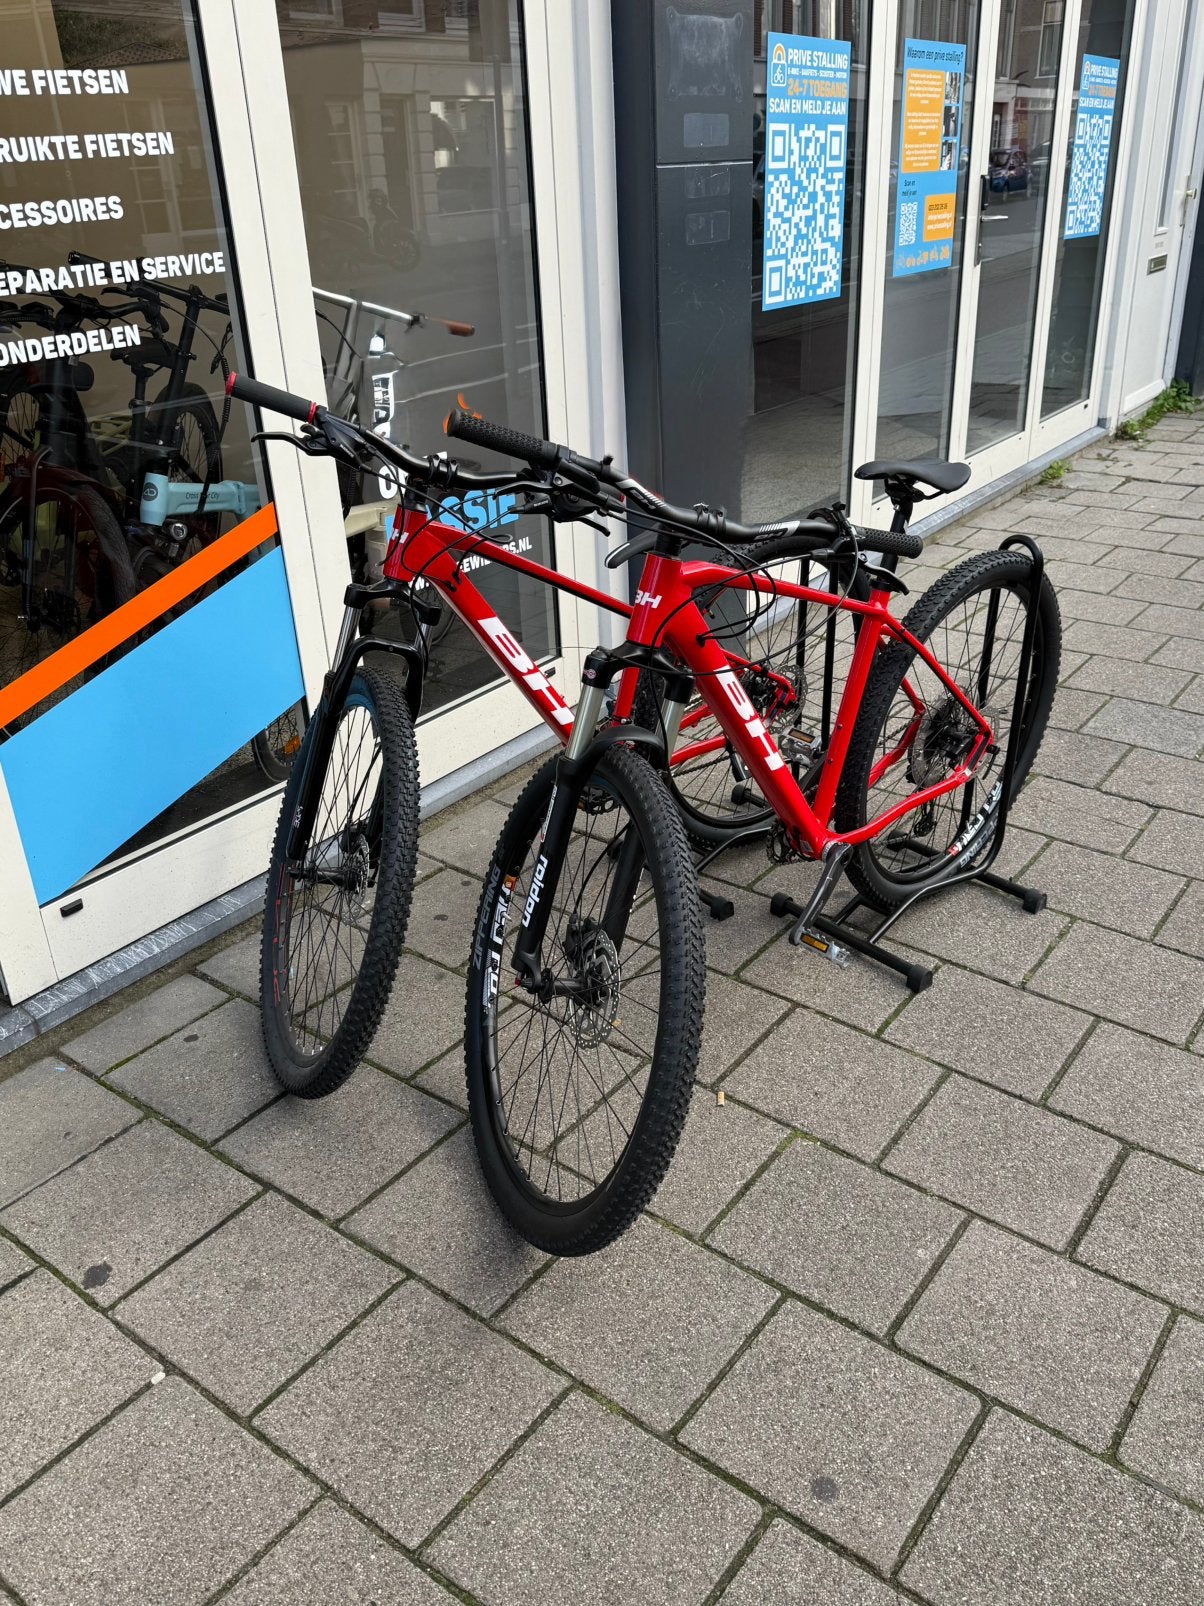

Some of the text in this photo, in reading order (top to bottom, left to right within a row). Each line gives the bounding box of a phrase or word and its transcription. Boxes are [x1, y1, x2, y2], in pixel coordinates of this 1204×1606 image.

[788, 48, 848, 69] PRIVE STALLING
[31, 68, 129, 95] FIETSEN
[788, 78, 847, 98] 24-7 TOEGANG
[769, 98, 846, 115] SCAN EN MELD JE AAN
[0, 131, 174, 163] RUIKTE FIETSEN
[0, 195, 124, 229] CESSOIRES
[109, 259, 140, 284] EN
[142, 251, 226, 280] SERVICE
[477, 616, 576, 726] BH
[713, 664, 785, 772] BH
[472, 866, 500, 971] ZIPPERING
